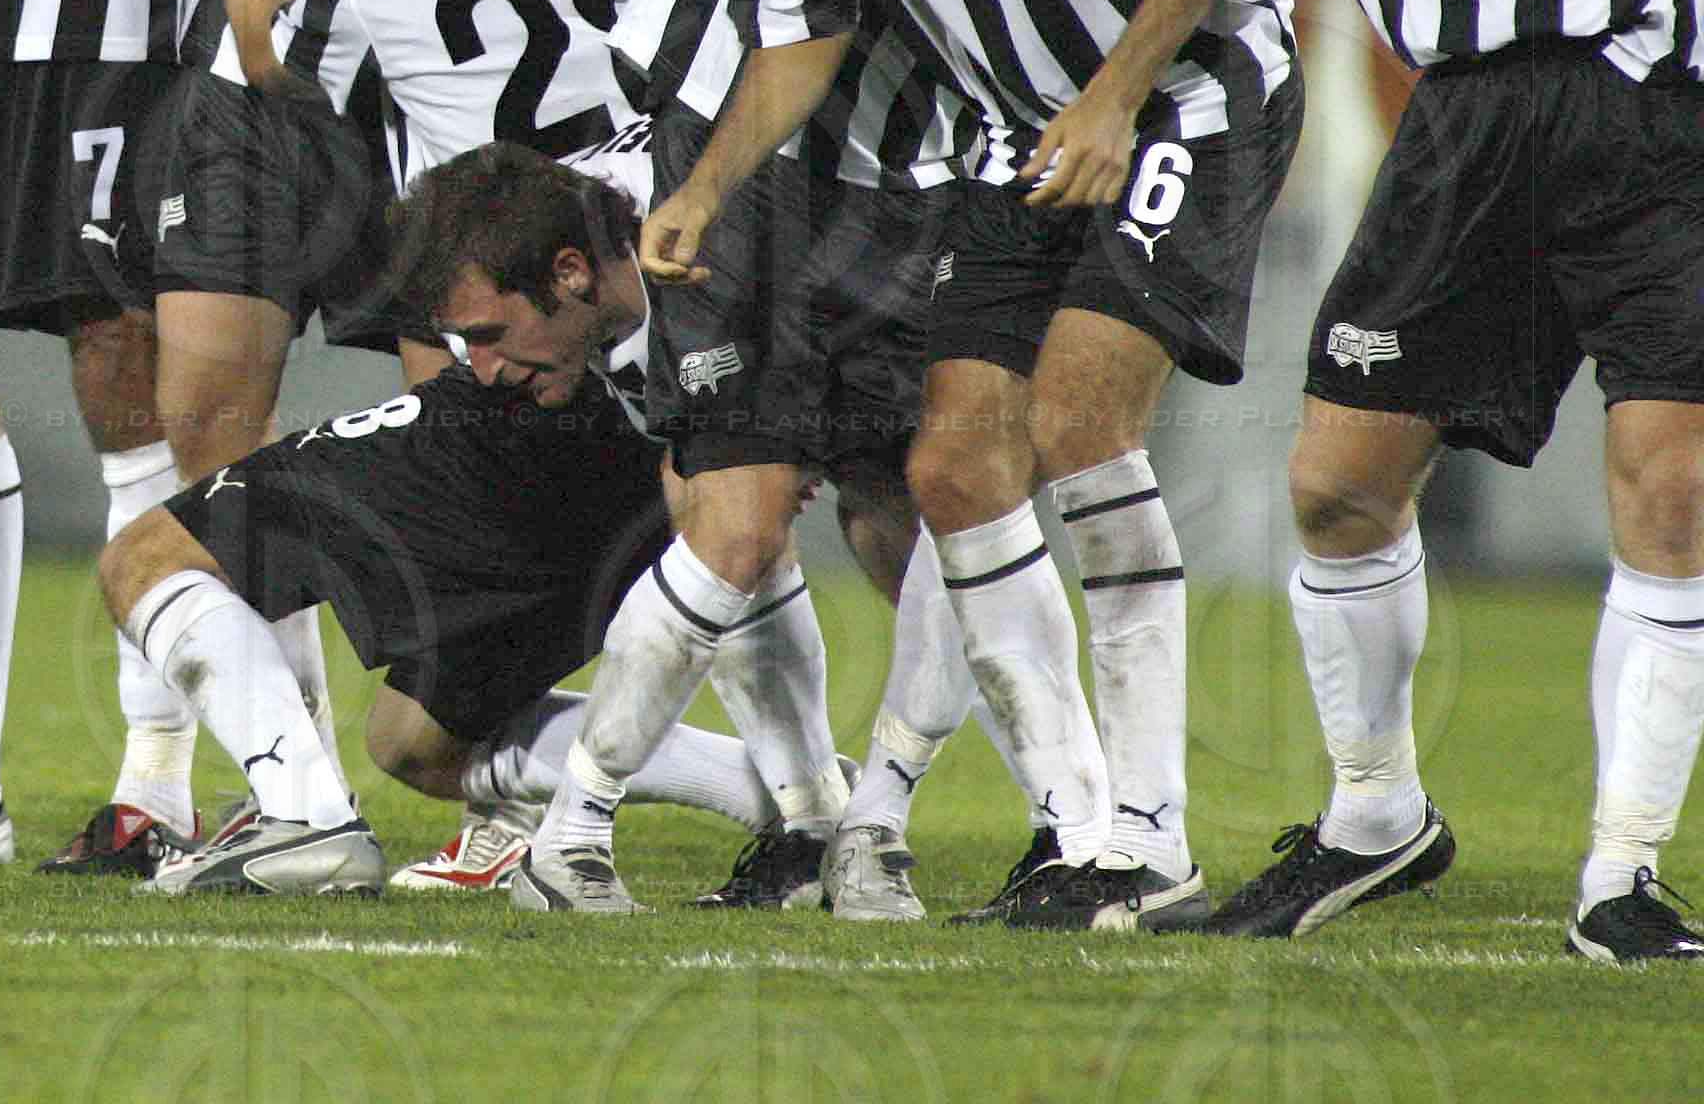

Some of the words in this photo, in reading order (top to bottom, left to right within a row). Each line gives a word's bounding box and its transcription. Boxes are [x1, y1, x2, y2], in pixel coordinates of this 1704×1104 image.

[71, 126, 125, 220] 7
[1128, 142, 1193, 225] 6
[332, 394, 422, 438] 8
